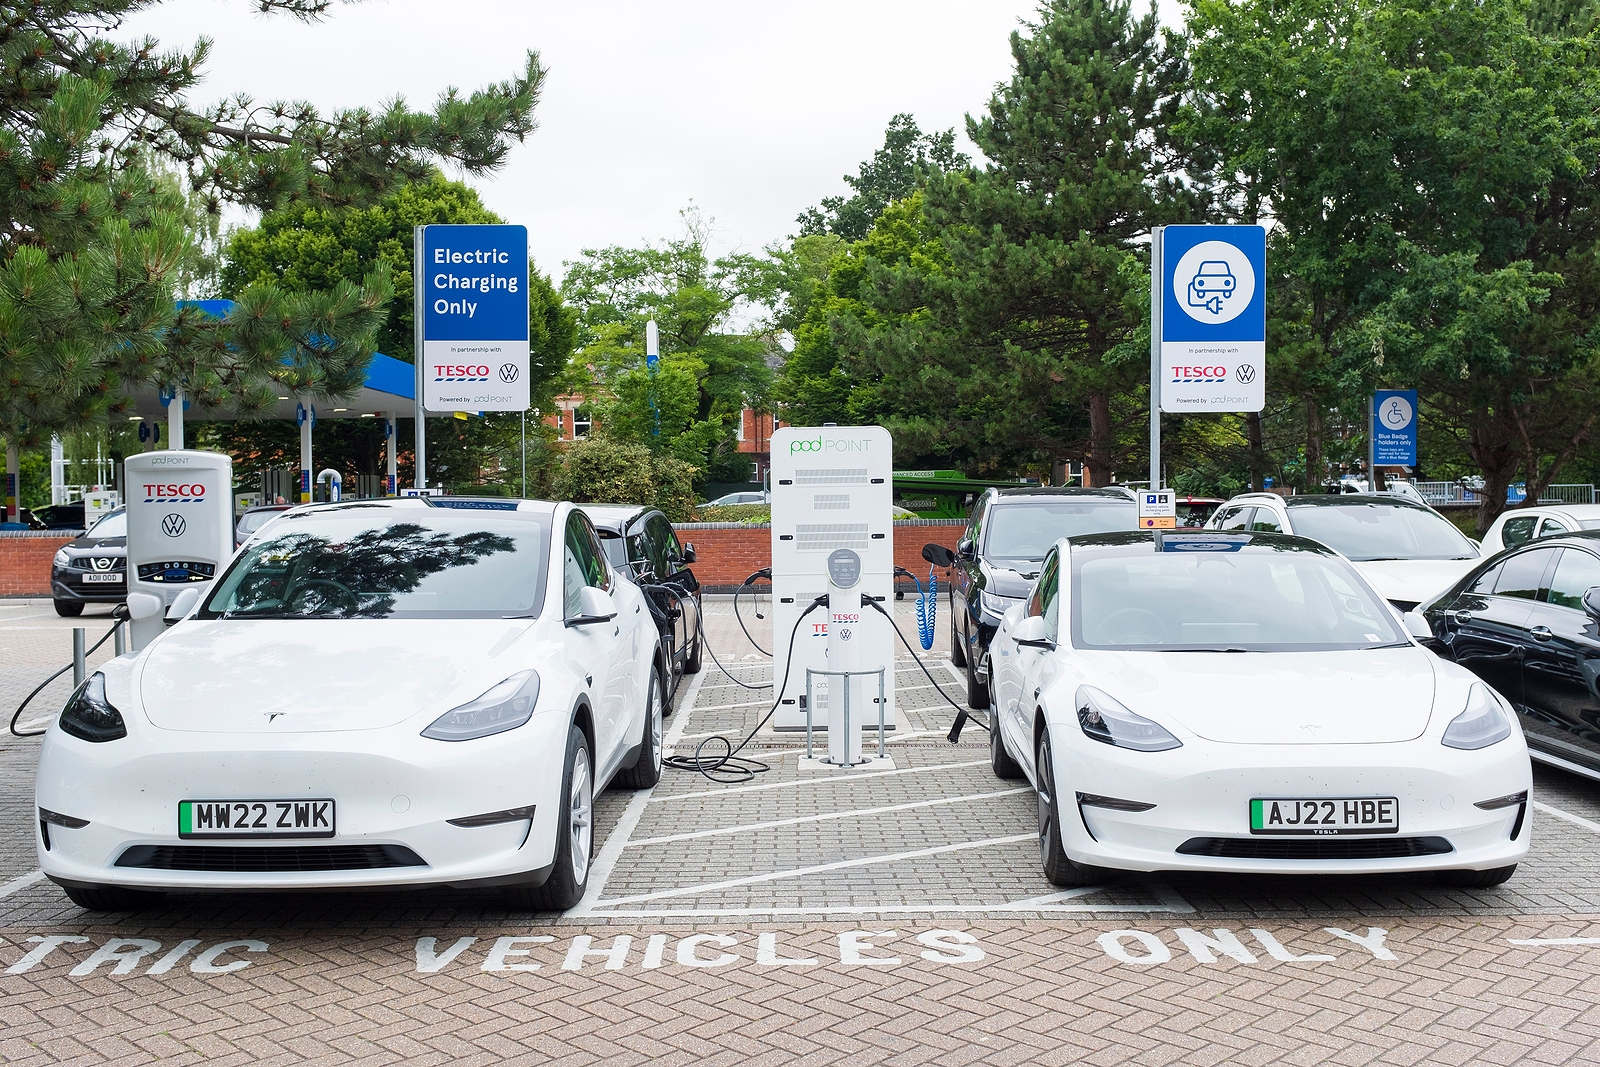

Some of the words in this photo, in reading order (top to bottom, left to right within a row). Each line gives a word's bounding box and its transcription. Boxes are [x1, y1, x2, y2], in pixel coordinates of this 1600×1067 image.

[434, 248, 509, 264] Electric
[434, 273, 519, 293] Charging
[434, 298, 478, 318] Only
[433, 365, 490, 377] TESCO
[1171, 366, 1226, 378] TESCO
[790, 435, 822, 457] pod
[826, 439, 872, 452] POINT
[143, 484, 206, 497] TESCO
[197, 804, 267, 828] MW22
[275, 803, 329, 828] ZWK
[1268, 802, 1336, 825] AJ22
[1344, 800, 1392, 824] HBE
[0, 934, 271, 977] TRIC
[414, 929, 987, 974] VEHICLES
[1095, 926, 1399, 967] ONLY
